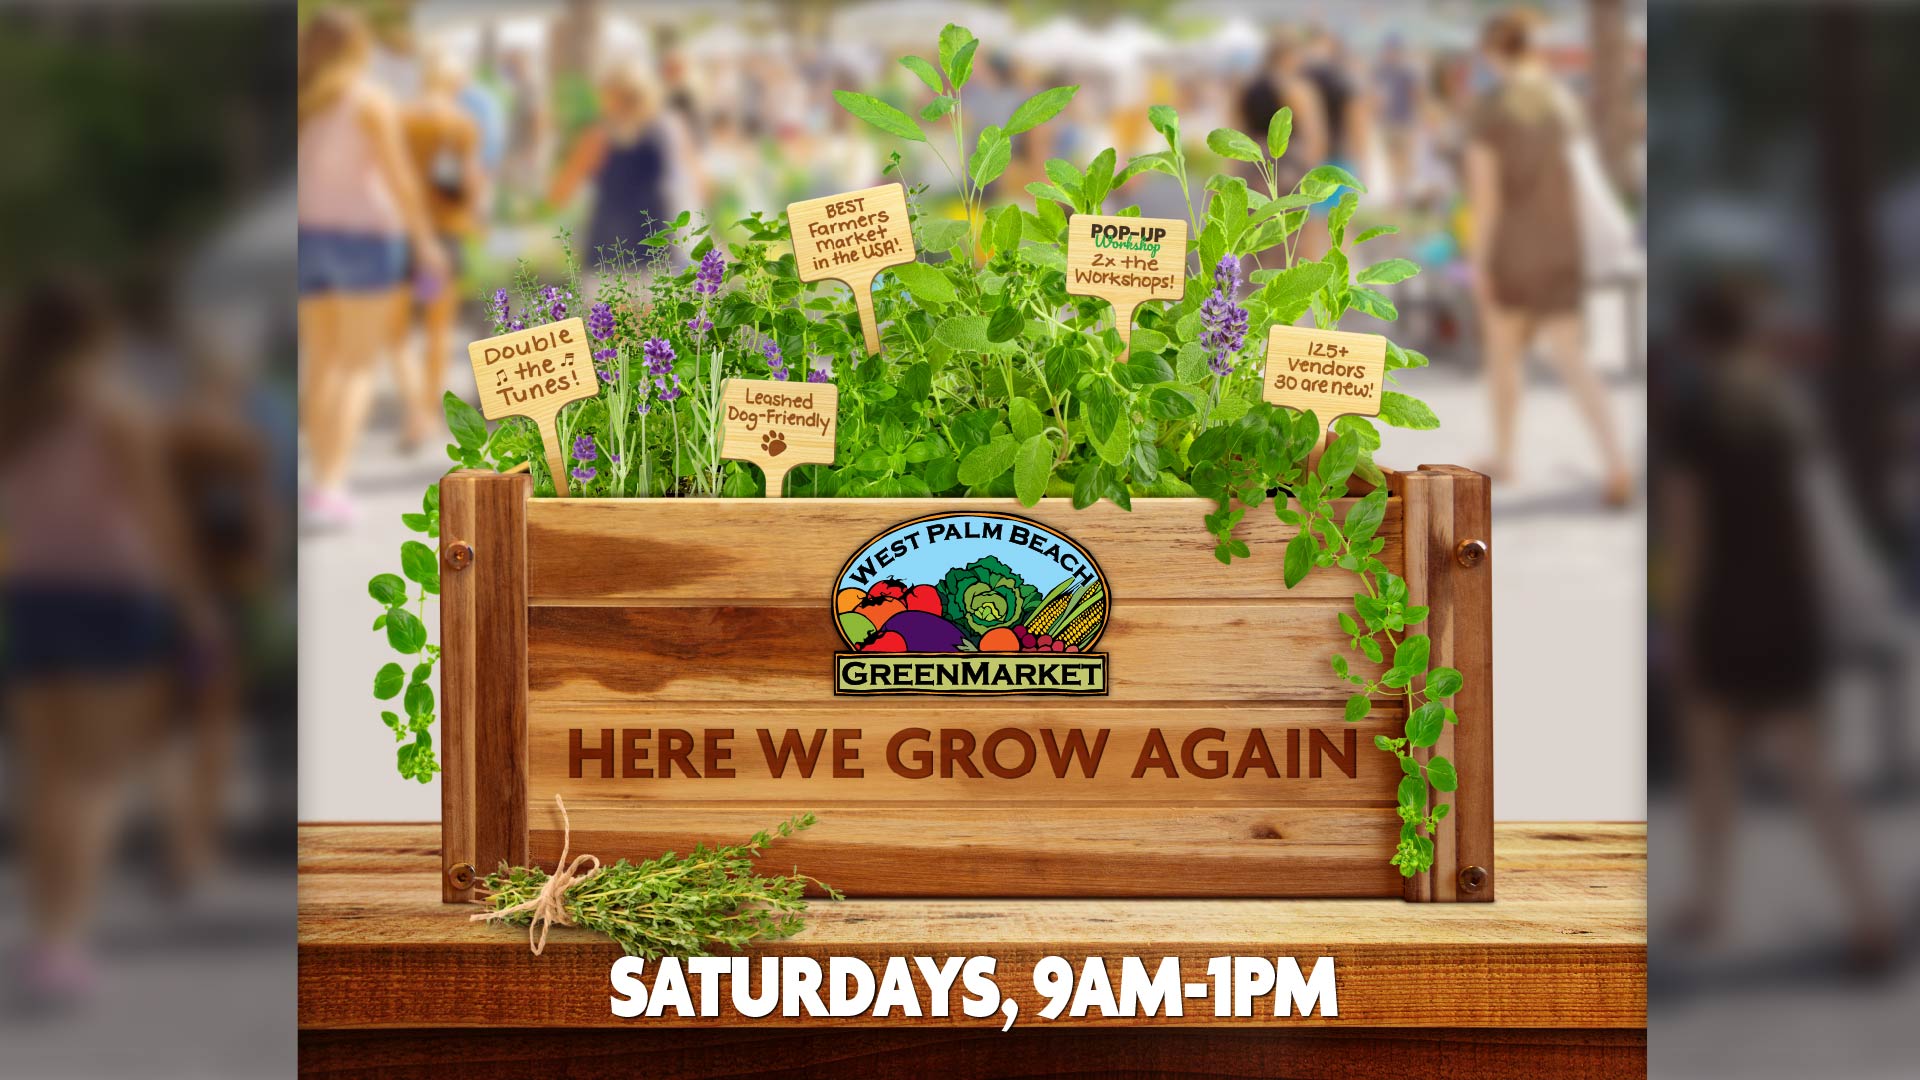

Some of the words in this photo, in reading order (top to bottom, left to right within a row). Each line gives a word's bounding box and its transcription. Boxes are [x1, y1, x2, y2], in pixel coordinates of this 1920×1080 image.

[825, 198, 865, 219] BEST
[808, 210, 890, 238] Farmers
[1091, 223, 1167, 243] POP-UP
[812, 256, 830, 270] in
[831, 250, 860, 265] the
[861, 237, 903, 259] USA!
[1095, 233, 1161, 259] Workshop
[1091, 253, 1116, 268] 2x
[1120, 255, 1160, 272] the
[1075, 268, 1175, 295] Workshops!
[484, 329, 574, 366] Double
[1307, 341, 1350, 359] 125+
[514, 358, 556, 380] the
[495, 369, 580, 406] Tunes!
[745, 387, 813, 410] Leashed
[1274, 374, 1298, 391] 30
[1300, 378, 1329, 394] are
[1331, 380, 1374, 398] new!
[728, 405, 831, 437] Dog-Friendly
[569, 728, 735, 779] HERE
[757, 728, 865, 779] WE
[885, 727, 1111, 780] GROW
[1131, 727, 1358, 780] AGAIN
